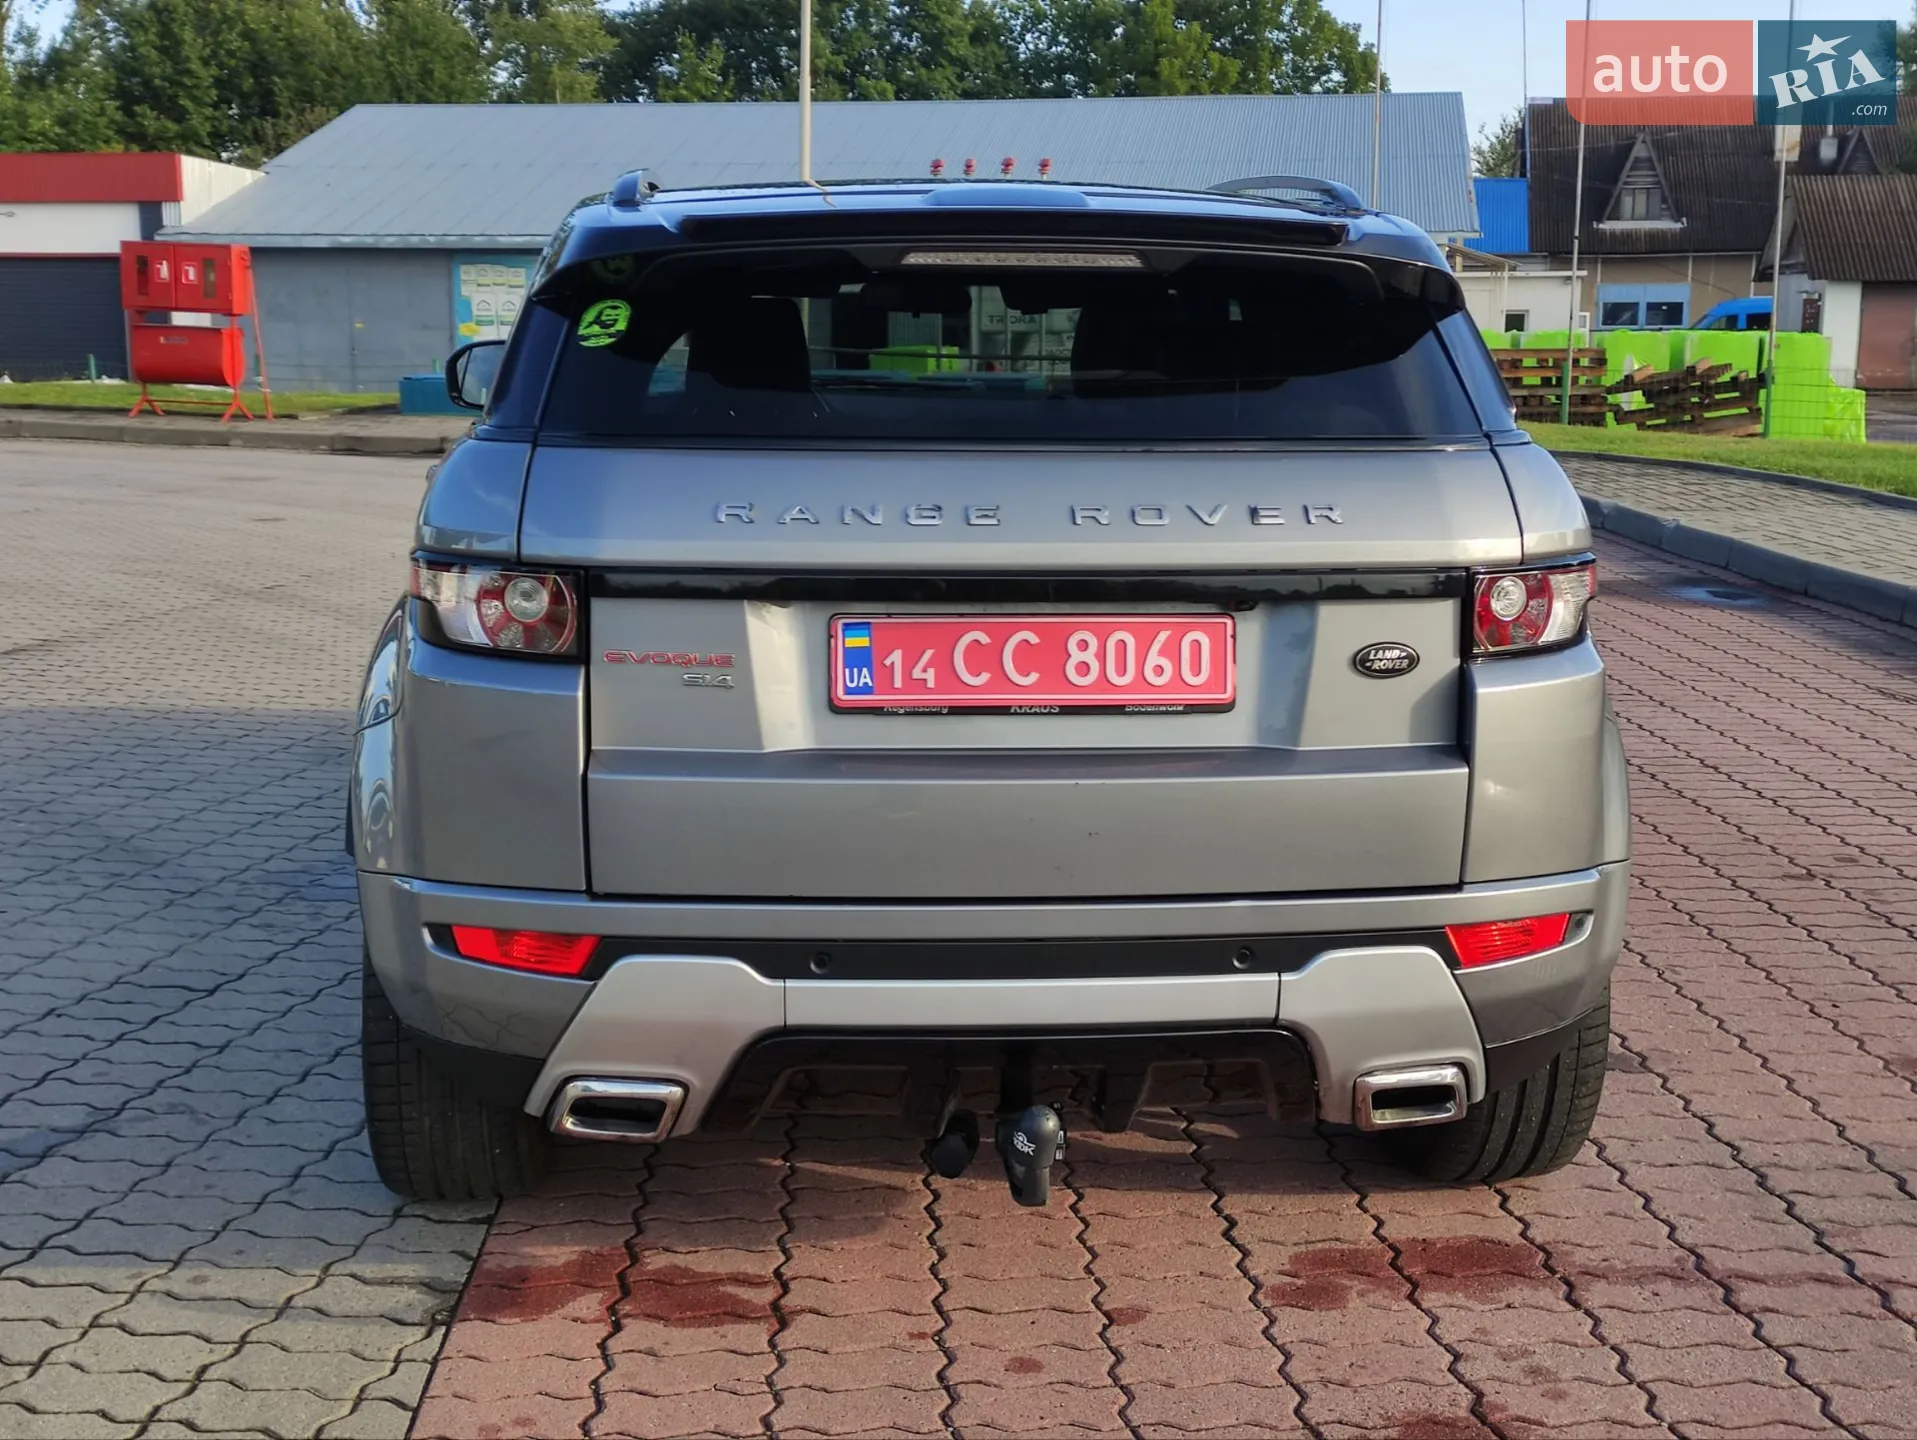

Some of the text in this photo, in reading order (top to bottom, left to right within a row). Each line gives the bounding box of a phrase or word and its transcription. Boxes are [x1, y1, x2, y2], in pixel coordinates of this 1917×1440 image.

[715, 502, 1346, 526] RANGE ROVER
[604, 650, 735, 668] EVOQUE
[882, 630, 1210, 689] 14 CC 8060
[1369, 649, 1401, 659] LAND
[1371, 660, 1409, 669] ROVER
[844, 668, 872, 688] UA
